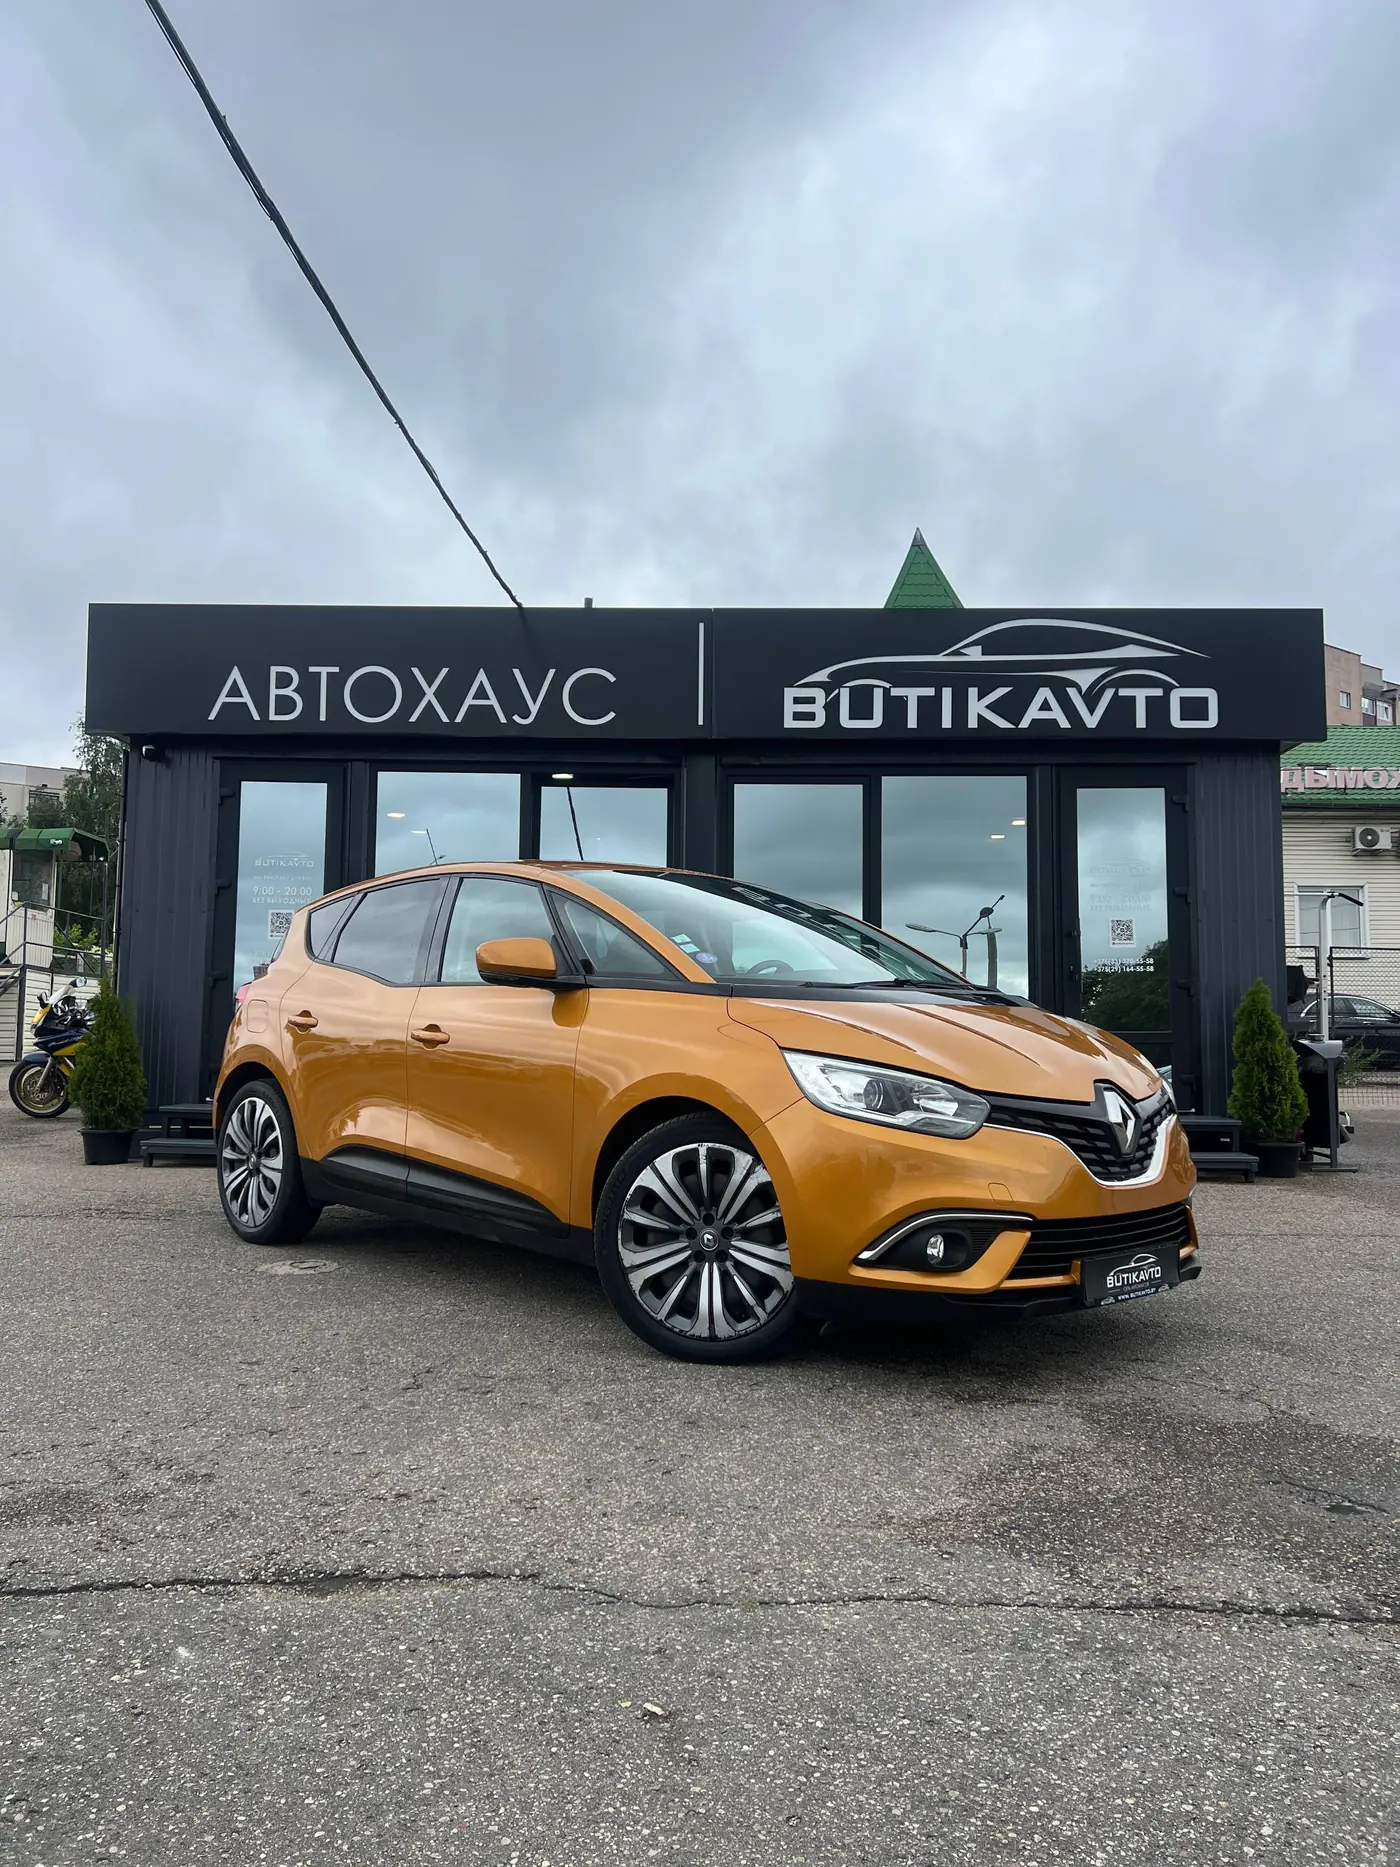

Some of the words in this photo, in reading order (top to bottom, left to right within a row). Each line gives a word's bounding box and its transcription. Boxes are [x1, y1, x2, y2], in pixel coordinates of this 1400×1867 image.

[207, 665, 617, 726] АВТОХАУС
[783, 686, 1219, 729] BUTIKAVTO
[254, 859, 315, 868] BUTIKAVTO
[1106, 1266, 1162, 1288] BUTIKAVTO
